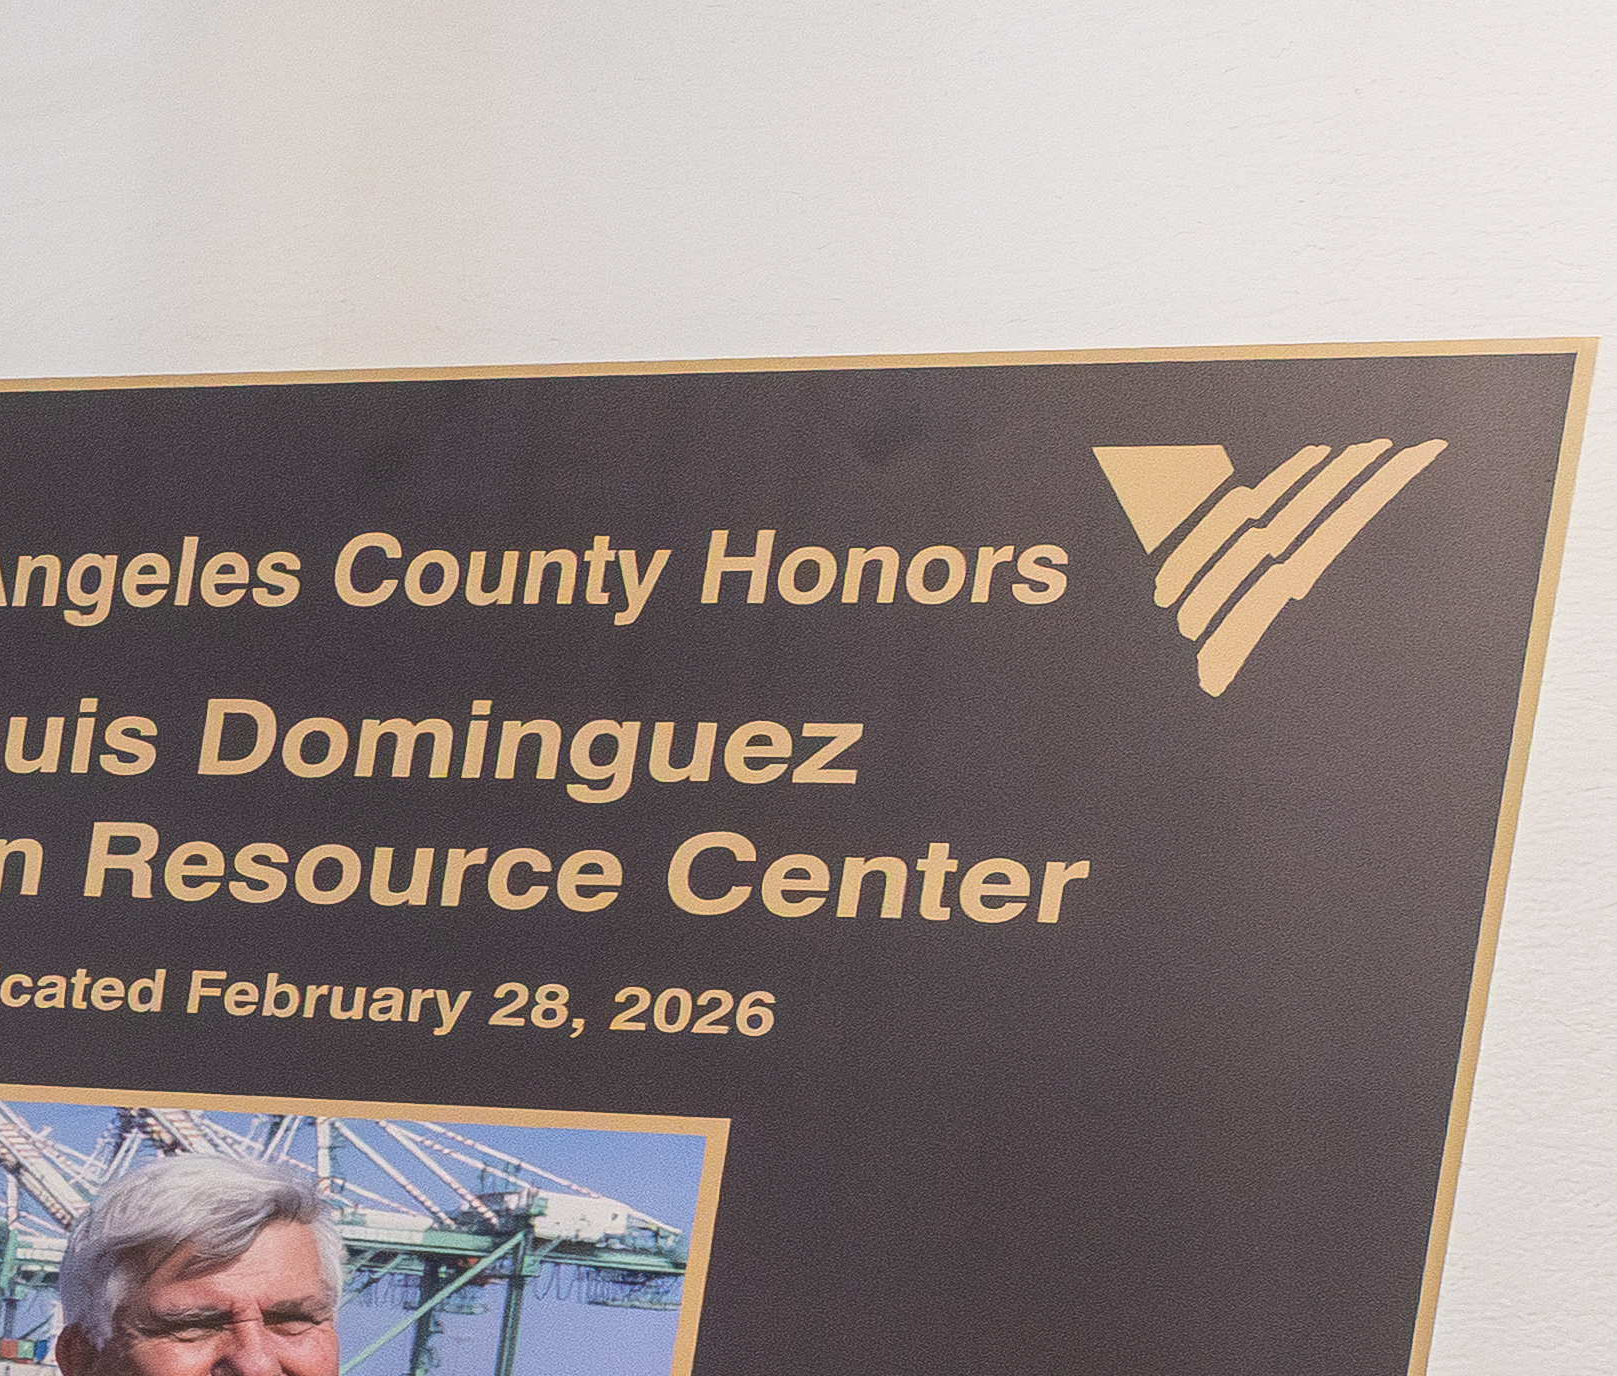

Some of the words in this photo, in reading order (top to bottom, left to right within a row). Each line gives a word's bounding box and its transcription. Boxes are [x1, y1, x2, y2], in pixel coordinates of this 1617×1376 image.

[333, 530, 673, 627] County
[699, 528, 1070, 606] Honors
[196, 697, 865, 805] Dominguez
[82, 820, 624, 914] Resource
[666, 829, 1092, 925] Center
[185, 969, 473, 1037] February
[487, 980, 587, 1039] 28,
[608, 985, 777, 1038] 2026
